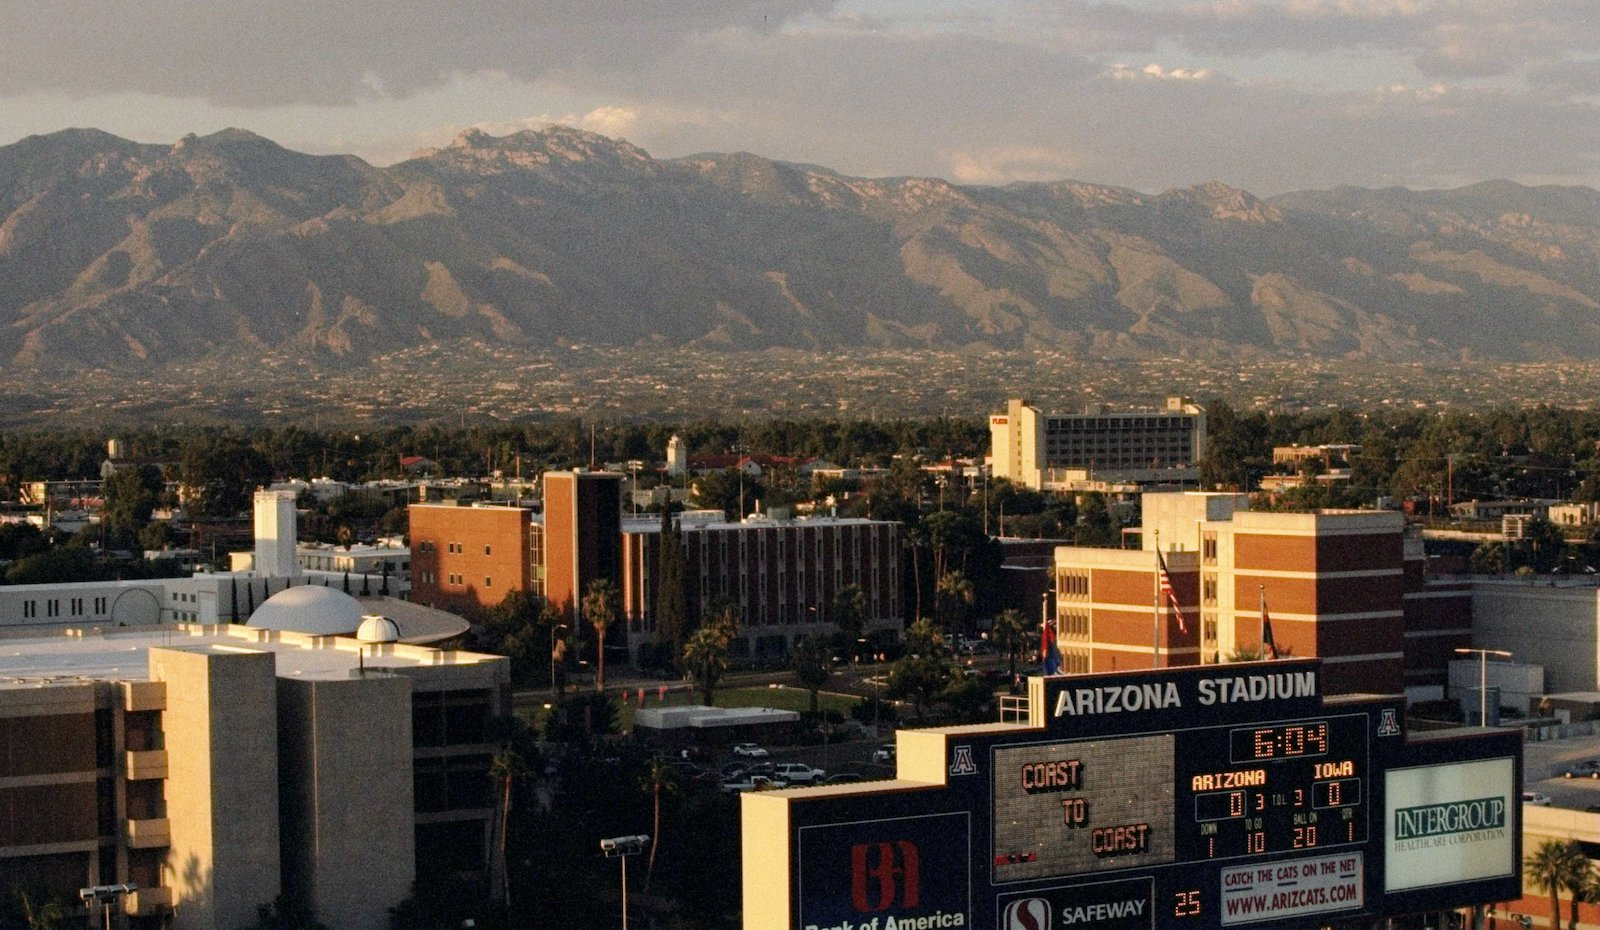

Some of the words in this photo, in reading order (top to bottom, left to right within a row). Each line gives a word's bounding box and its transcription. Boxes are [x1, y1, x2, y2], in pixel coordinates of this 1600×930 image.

[1054, 682, 1181, 717] ARIZONA
[1198, 672, 1316, 706] STADIUM
[1255, 725, 1326, 757] 6:04
[1022, 759, 1083, 792] COAST
[1192, 769, 1266, 791] ARIZONA
[1314, 760, 1353, 779] IOWA
[1231, 792, 1241, 816] 0
[1255, 793, 1264, 810] 3
[1294, 789, 1303, 806] 3
[1329, 782, 1340, 805] 0
[1061, 797, 1087, 827] TO
[1293, 813, 1307, 826] BALL
[1309, 812, 1318, 824] ON
[1396, 800, 1504, 838] INTERGROUP
[1201, 822, 1217, 835] DOWN
[1245, 818, 1252, 831] TO
[1254, 818, 1263, 830] GO
[1092, 823, 1150, 856] COAST
[1208, 837, 1213, 858] 1
[1247, 832, 1265, 853] 10
[1293, 826, 1316, 848] 20
[1395, 836, 1447, 852] HEALTHCARE
[1449, 829, 1505, 846] CORPORATION
[1225, 871, 1254, 887] CATCH
[1257, 869, 1273, 882] THE
[1277, 865, 1298, 881] CATS
[1303, 864, 1317, 878] ON
[1320, 861, 1336, 875] THE
[1340, 859, 1356, 873] NET
[1175, 890, 1200, 917] 25
[1226, 884, 1357, 916] WWW.ARIZCATS.COM
[859, 917, 879, 930] of
[884, 910, 965, 930] America
[1062, 899, 1147, 925] SAFEWAY
